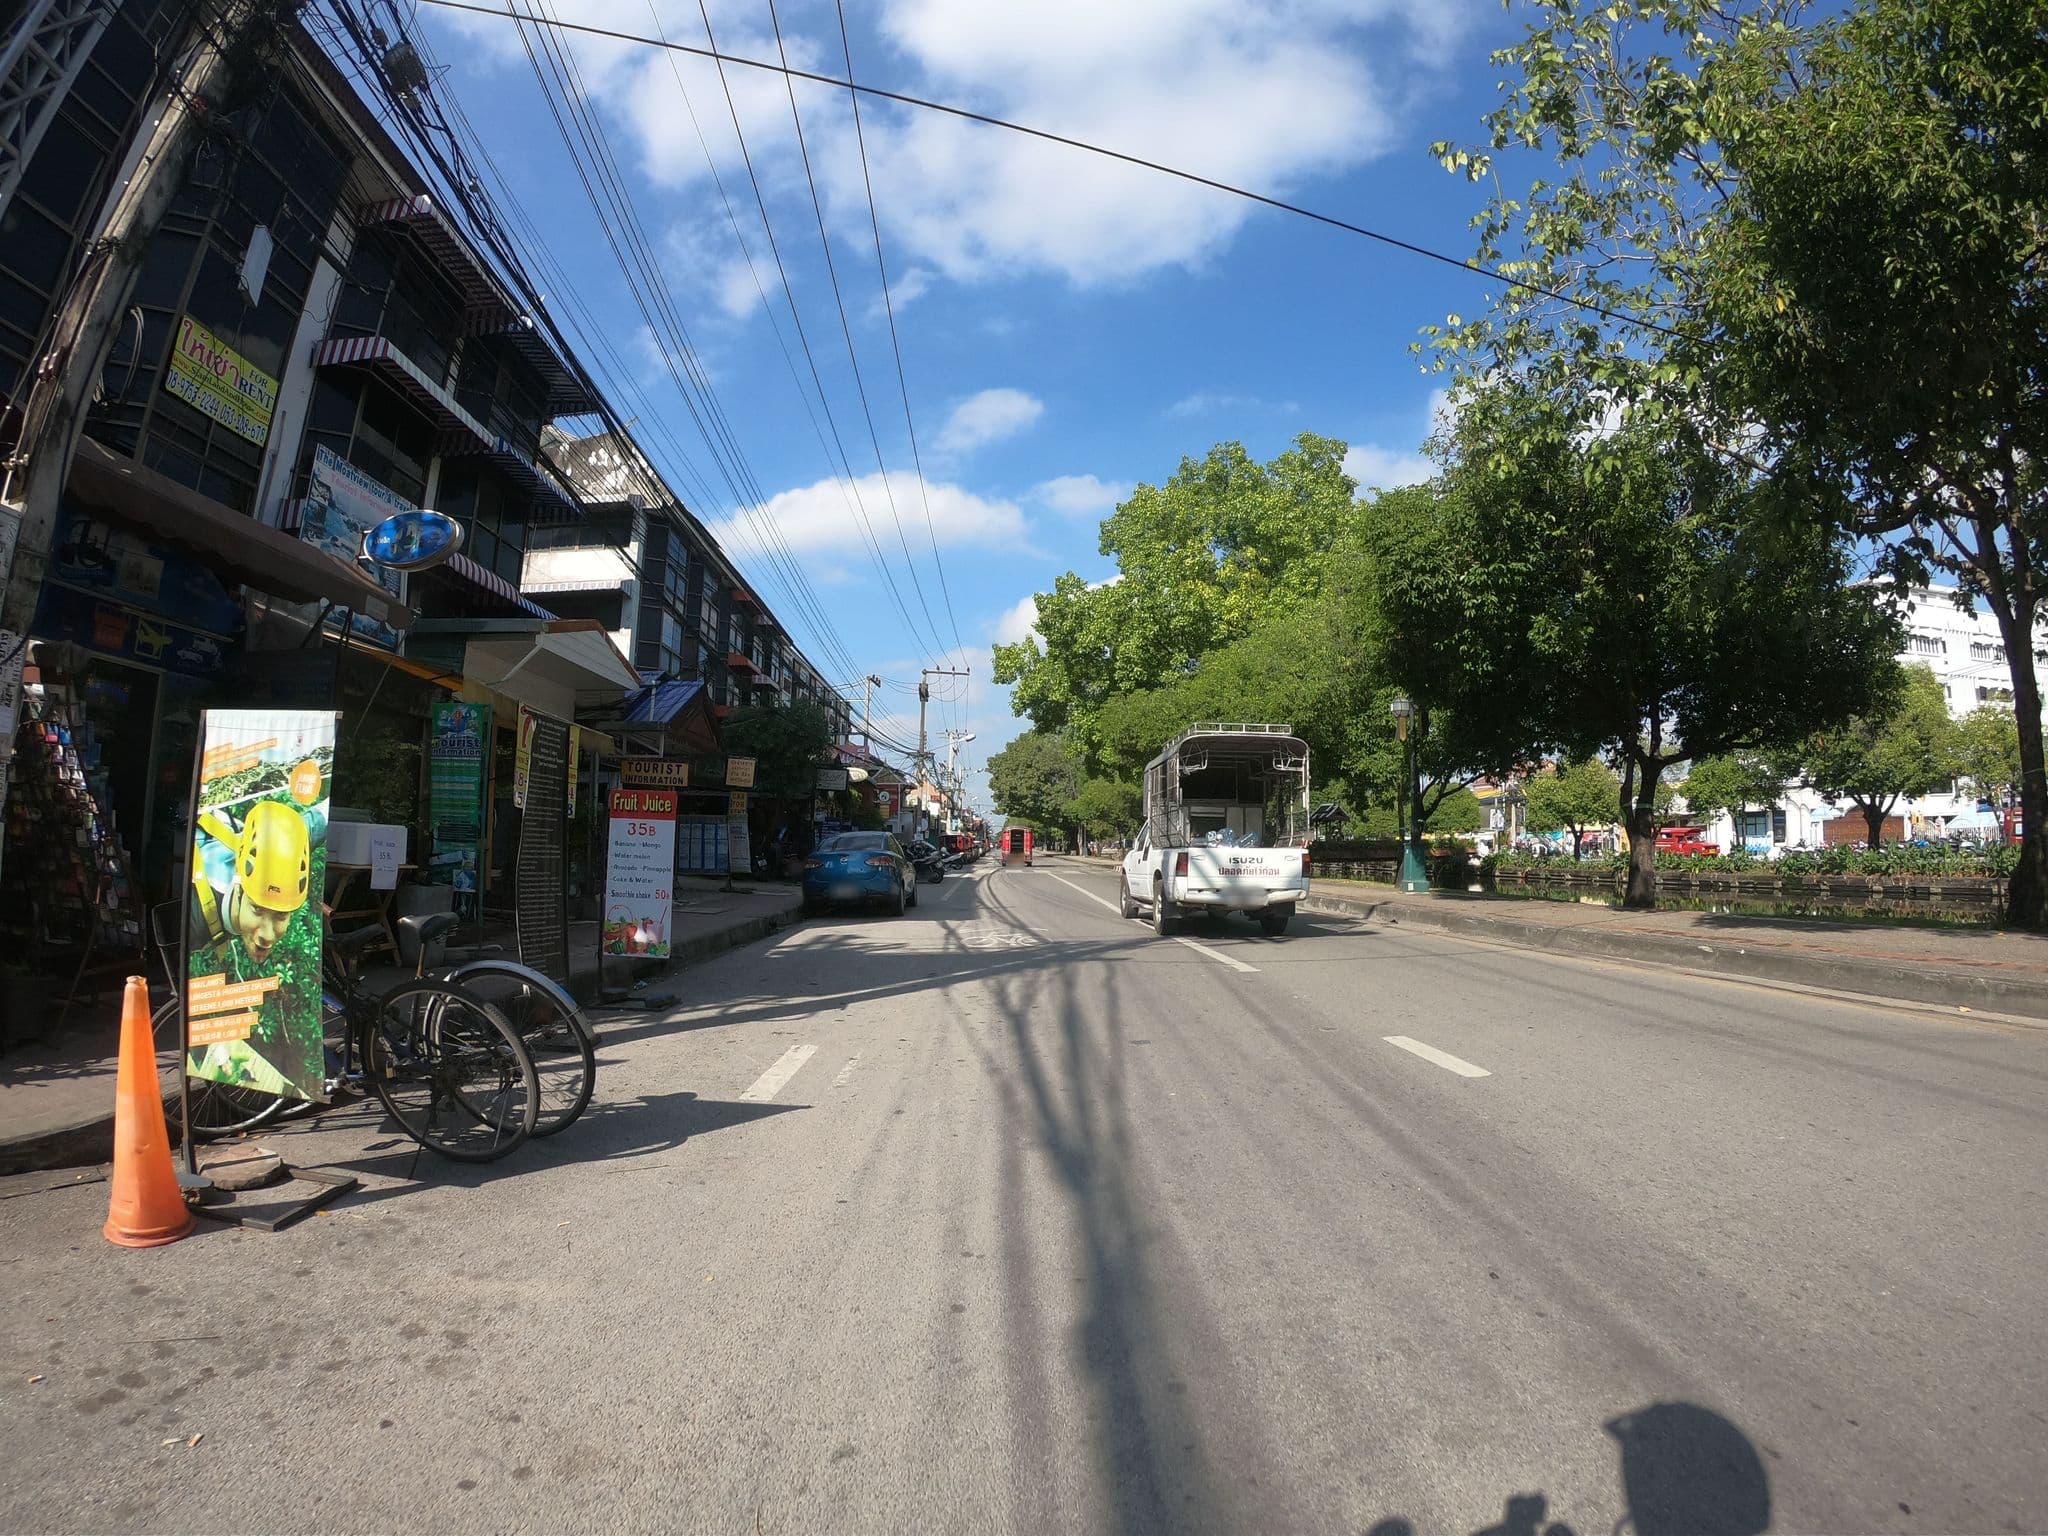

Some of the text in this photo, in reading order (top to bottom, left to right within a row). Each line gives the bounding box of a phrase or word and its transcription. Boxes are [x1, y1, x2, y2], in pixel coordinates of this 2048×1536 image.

[183, 319, 241, 388] ให้เช่า
[249, 369, 268, 388] FOR
[239, 376, 275, 409] RENT
[318, 450, 333, 468] The
[335, 459, 370, 491] Moatview
[371, 482, 387, 499] tour
[627, 761, 683, 775] TOURIST
[625, 774, 684, 785] INFORMATION
[613, 792, 673, 812] Fruit Juice
